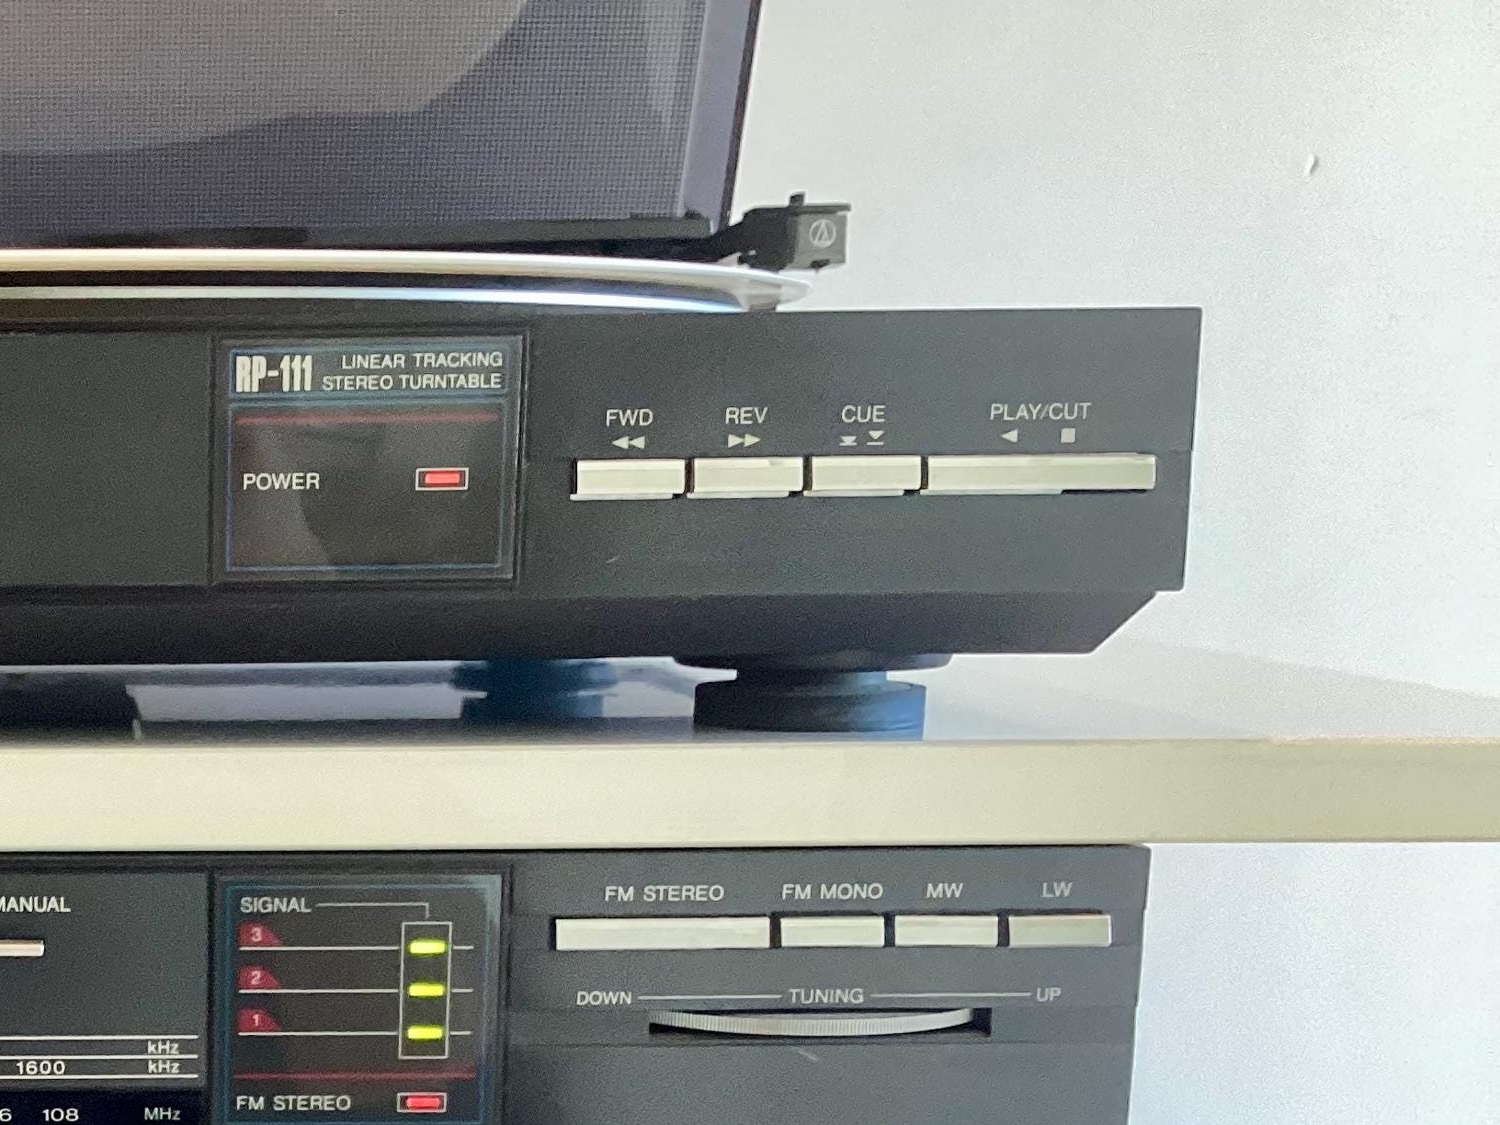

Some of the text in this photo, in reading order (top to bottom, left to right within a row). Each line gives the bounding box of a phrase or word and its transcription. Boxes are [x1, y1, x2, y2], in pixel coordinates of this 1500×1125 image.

[342, 351, 503, 370] LINEAR TRACKING
[236, 354, 313, 393] RP-111
[321, 373, 501, 392] STEREO TURNTABLE
[605, 408, 654, 427] FWD
[725, 406, 768, 425] REV
[841, 404, 886, 424] CUE
[989, 402, 1092, 421] PLAY/CUT
[243, 472, 320, 491] POWER
[604, 884, 725, 902] FM STEREO
[782, 882, 884, 900] FM MONO
[926, 882, 964, 899] MW
[1042, 881, 1073, 898] LW
[240, 896, 312, 913] SIGNAL
[250, 927, 263, 943] 3
[250, 970, 262, 986] 2
[576, 990, 632, 1006] DOWN
[788, 987, 865, 1004] TUNING
[1036, 987, 1062, 1002] UP
[252, 1013, 260, 1027] 1
[147, 1040, 180, 1056] kHz
[16, 1060, 66, 1076] 1600
[147, 1060, 180, 1075] kHz
[236, 1094, 352, 1111] FM STEREO
[42, 1107, 80, 1123] 108
[144, 1106, 181, 1121] MHz
